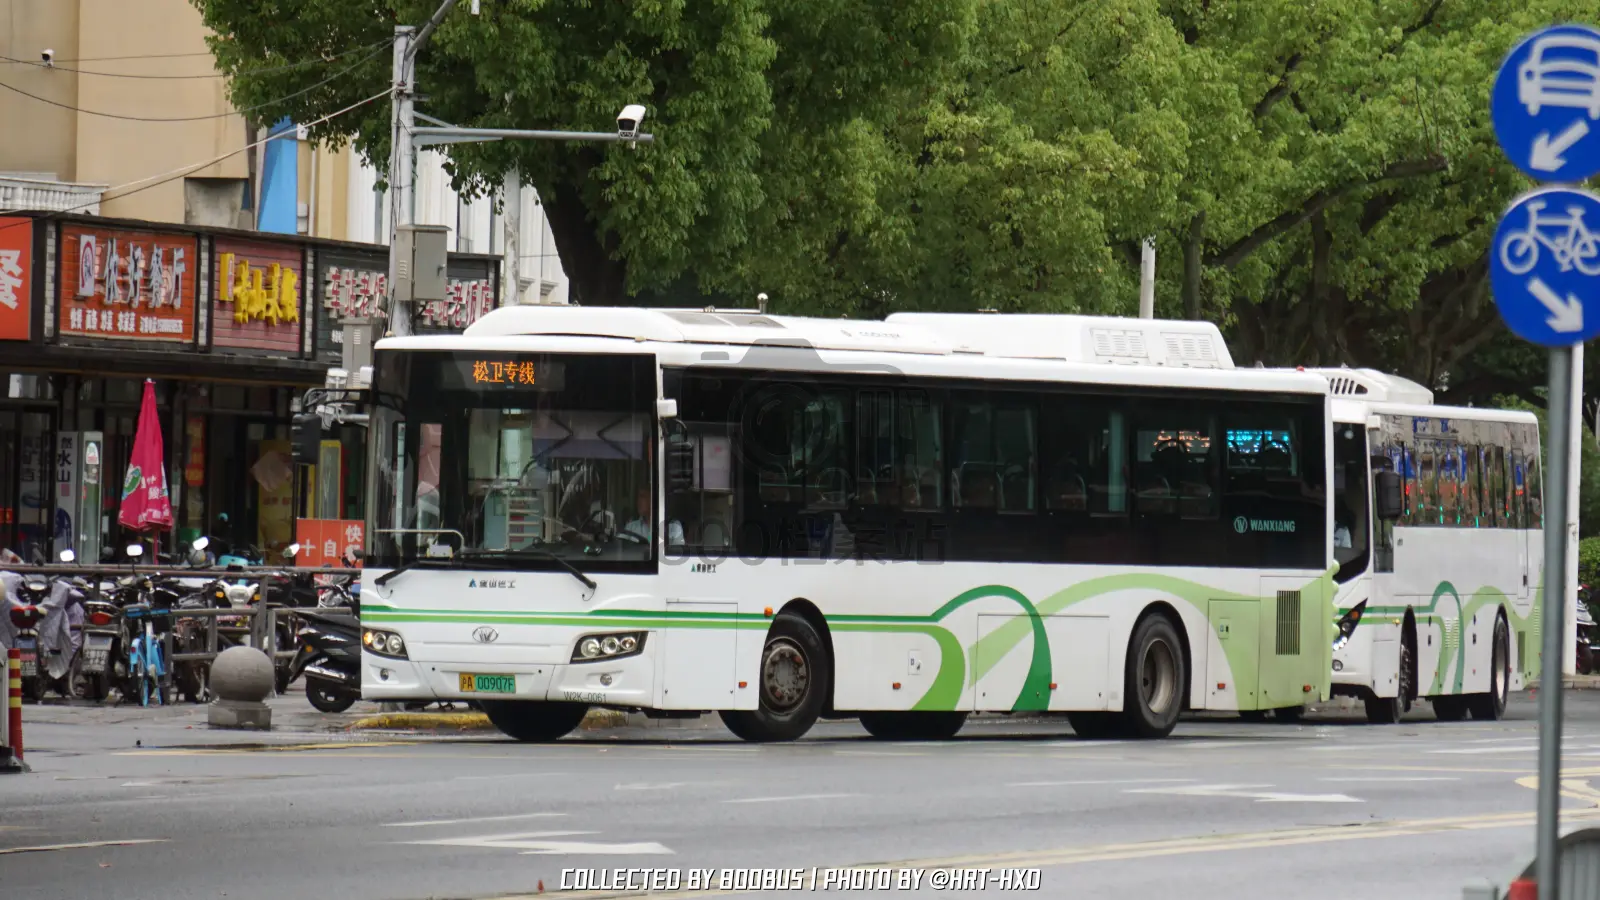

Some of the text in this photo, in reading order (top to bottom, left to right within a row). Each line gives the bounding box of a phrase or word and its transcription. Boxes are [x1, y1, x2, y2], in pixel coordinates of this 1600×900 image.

[324, 266, 388, 318] 车站老饭
[473, 360, 535, 384] 松卫专线
[1251, 519, 1295, 532] WANXIANG
